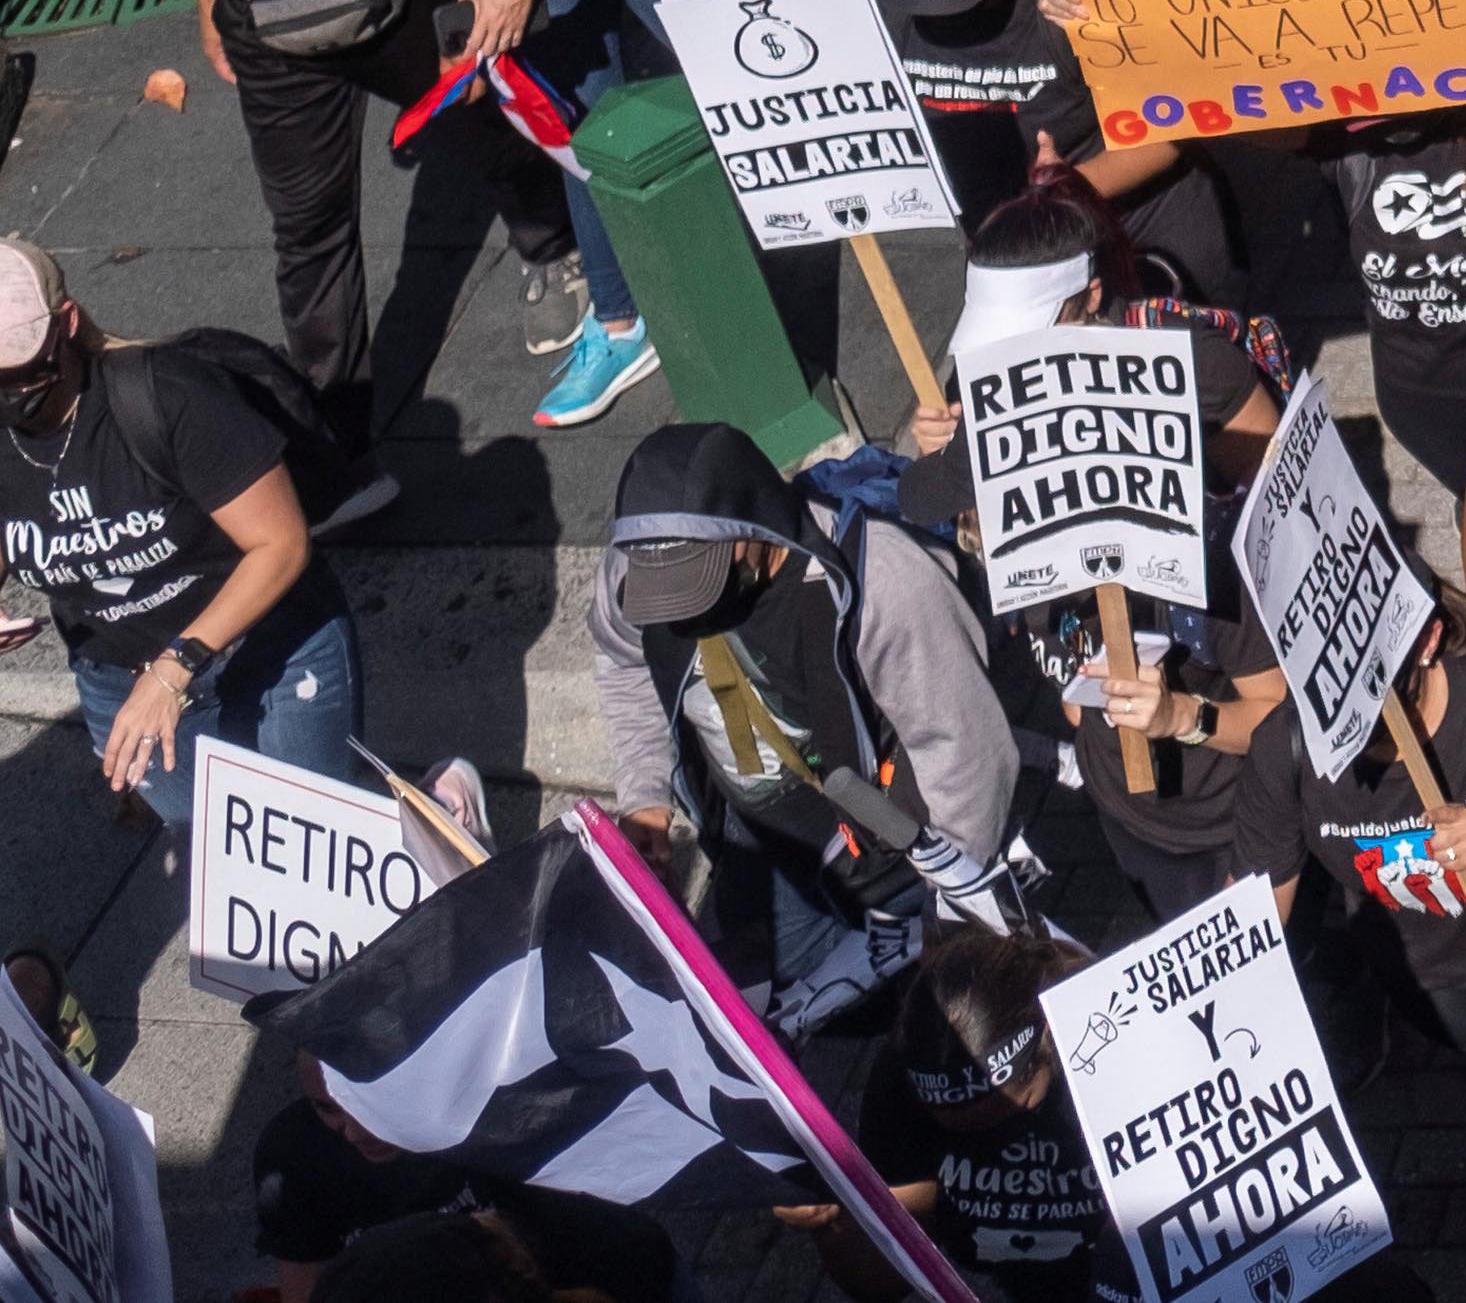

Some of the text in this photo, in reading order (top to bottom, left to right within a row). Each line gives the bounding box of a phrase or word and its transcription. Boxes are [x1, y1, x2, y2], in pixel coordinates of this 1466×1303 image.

[1077, 23, 1157, 69] SE
[1171, 16, 1253, 60] VA
[1277, 8, 1313, 49] A
[1259, 43, 1367, 68] ES TU
[705, 79, 907, 137] JUSTICIA
[726, 130, 925, 189] SALARIAL
[970, 354, 1187, 423] RETIRO
[986, 411, 1184, 472] DIGNO
[49, 486, 92, 525] SIN
[999, 460, 1187, 534] AHORA
[6, 504, 166, 569] Maestros
[105, 536, 178, 575] PARALIZA
[224, 794, 422, 915] RETIRO
[1123, 907, 1238, 993] JUSTICIA
[1149, 922, 1282, 1013] SALARIAL
[1188, 1000, 1220, 1062] Y
[1103, 1068, 1241, 1179] RETIRO
[1174, 1068, 1315, 1190] DIGNO
[1159, 1134, 1348, 1290] AHORA
